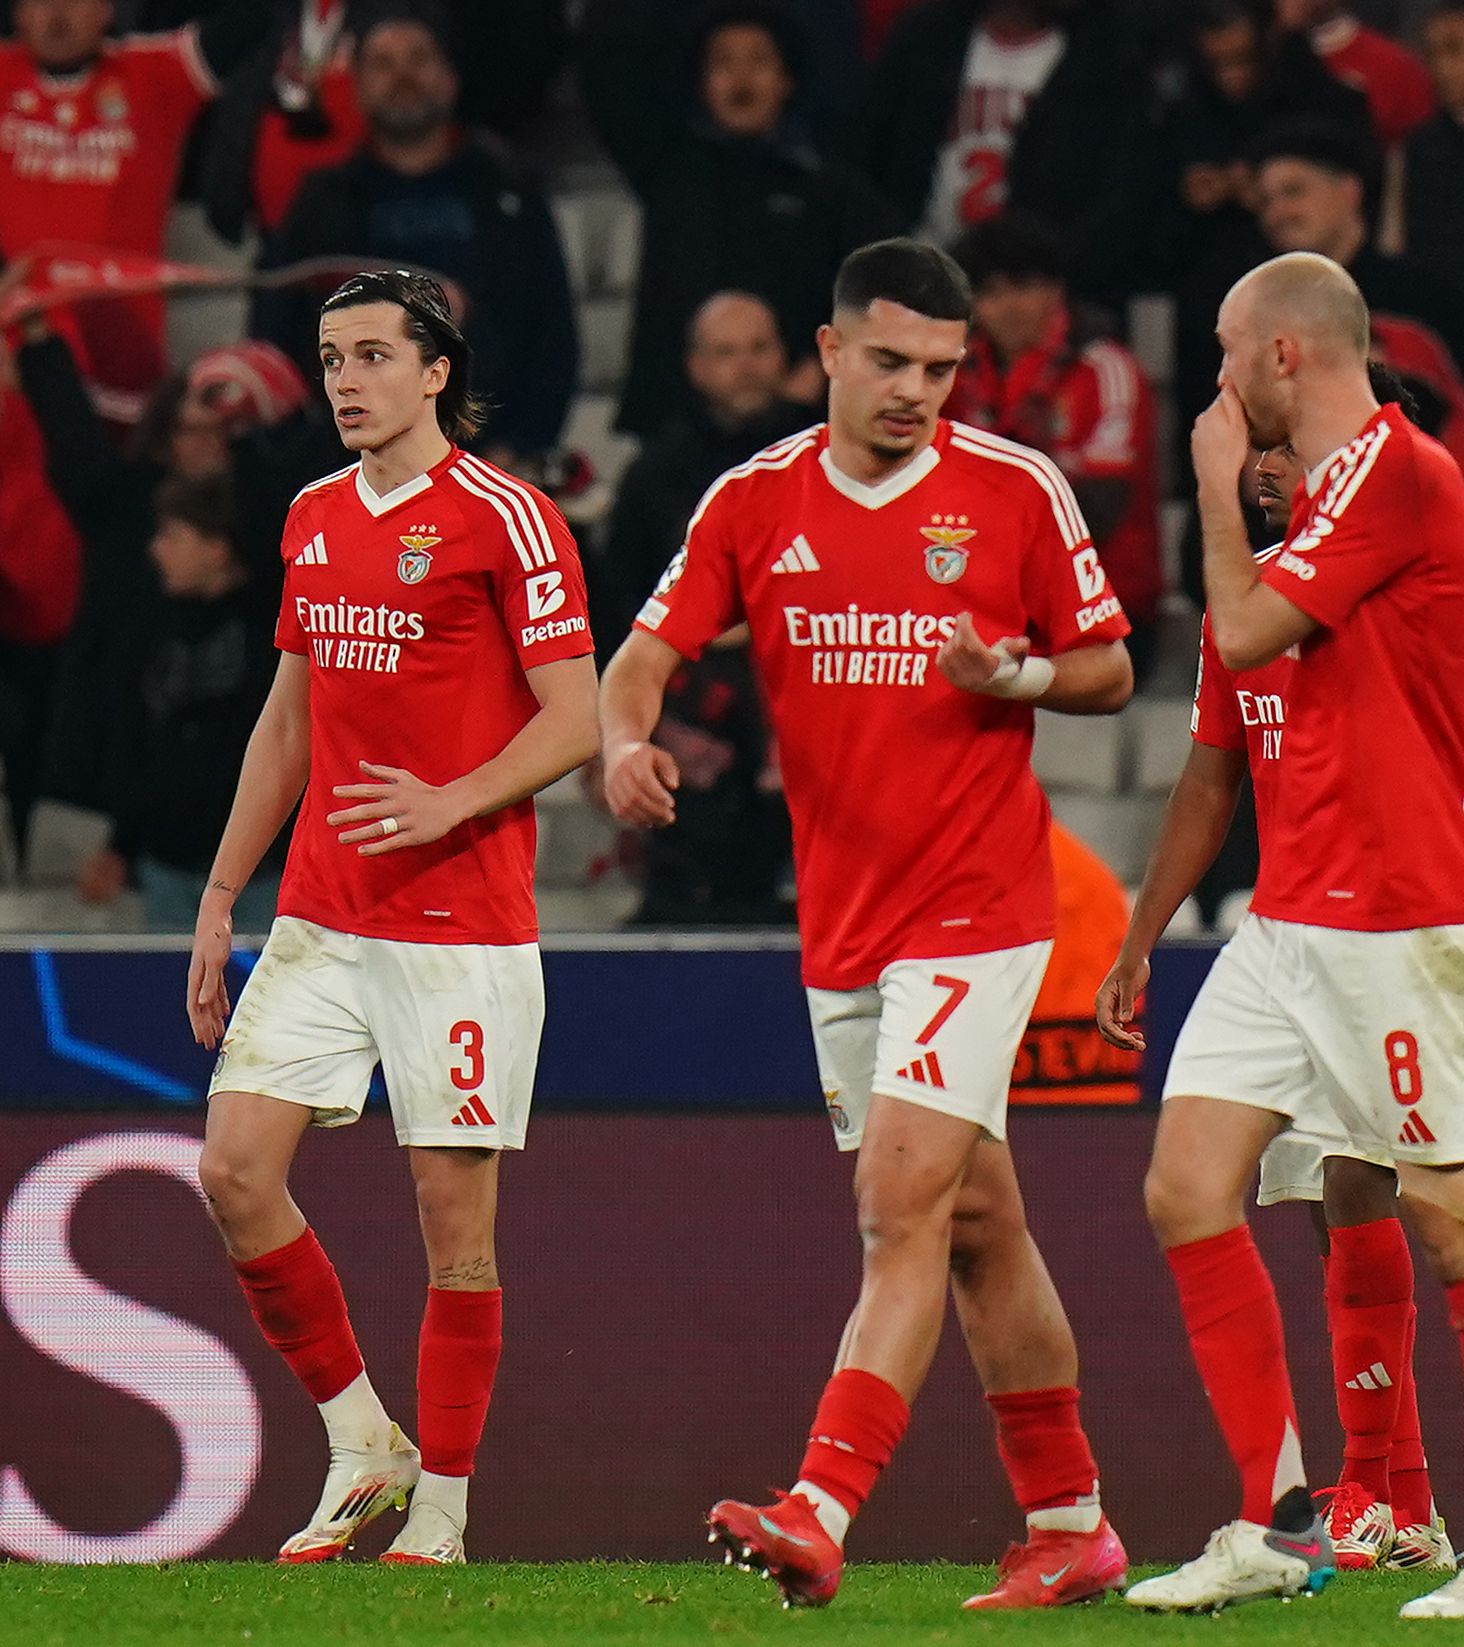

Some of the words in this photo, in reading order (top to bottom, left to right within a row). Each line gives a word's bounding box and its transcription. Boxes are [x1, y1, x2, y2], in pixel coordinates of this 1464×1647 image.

[295, 595, 425, 640] Emirates
[521, 615, 586, 647] Betano
[783, 603, 958, 649] Emirates
[312, 638, 334, 668] FLY
[335, 639, 401, 674] BETTER
[811, 651, 845, 684] FLY
[846, 651, 928, 686] BETTER
[1236, 690, 1285, 726] Em
[1262, 729, 1283, 760] FLY
[915, 974, 971, 1046] 7
[449, 1020, 485, 1091] 3
[1384, 1029, 1423, 1105] 8
